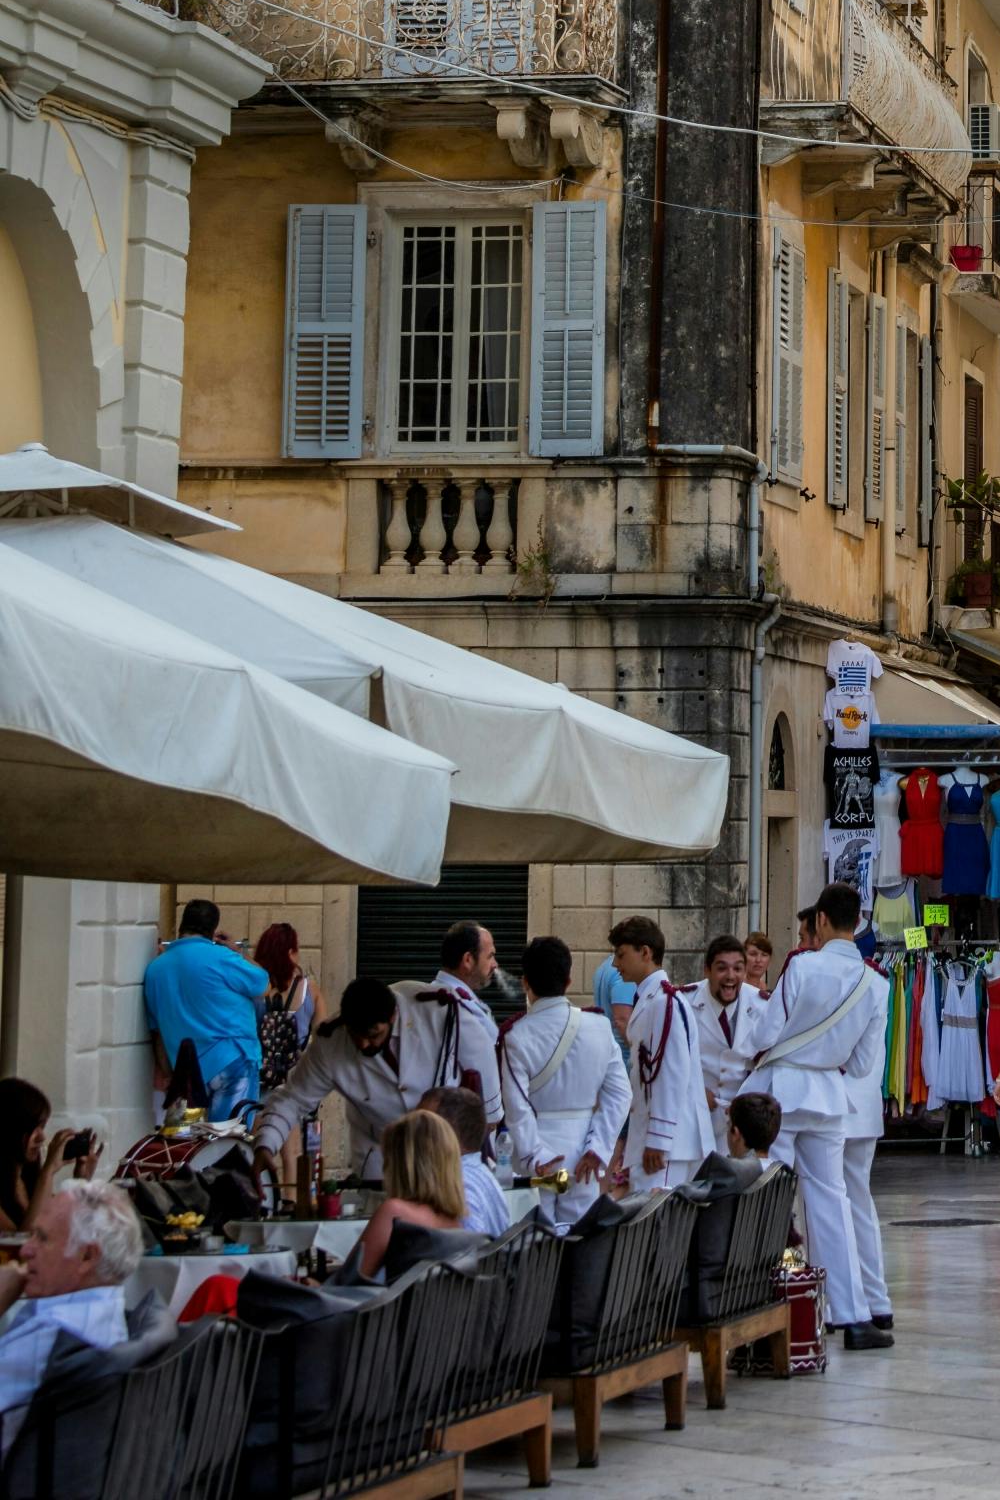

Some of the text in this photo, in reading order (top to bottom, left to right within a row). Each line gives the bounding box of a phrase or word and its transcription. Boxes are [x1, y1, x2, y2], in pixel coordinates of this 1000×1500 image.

[850, 710, 868, 722] Rock
[833, 756, 872, 767] ACHILLES
[834, 812, 874, 823] CORFU
[832, 832, 846, 844] THIS
[847, 831, 853, 839] IS
